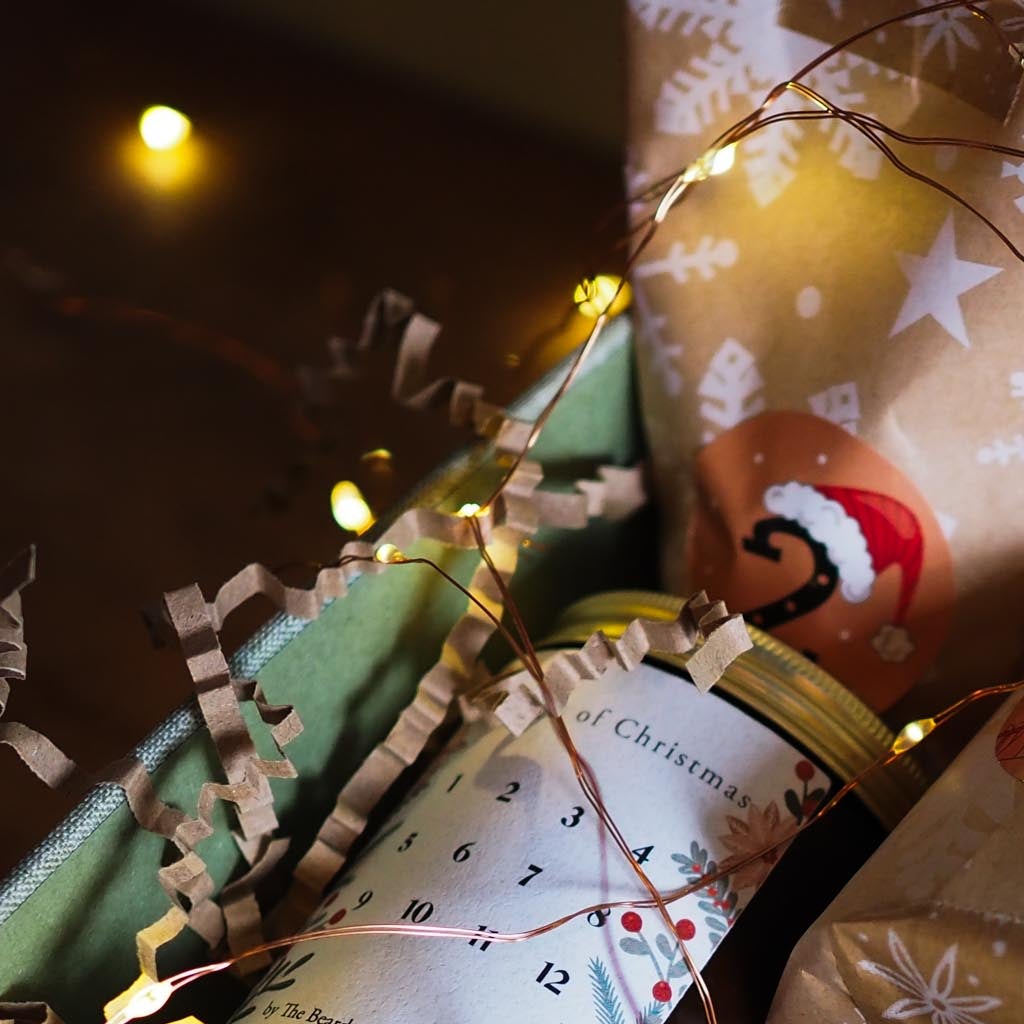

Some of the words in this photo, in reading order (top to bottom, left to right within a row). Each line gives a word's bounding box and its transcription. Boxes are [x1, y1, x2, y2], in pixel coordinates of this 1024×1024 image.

[576, 708, 612, 727] of
[614, 717, 752, 809] Christmas
[397, 832, 418, 853] 5
[452, 842, 477, 863] 6
[518, 864, 543, 886] 7
[447, 773, 463, 793] 1
[496, 781, 520, 803] 2
[560, 806, 585, 828] 3
[631, 845, 654, 865] 4
[352, 890, 374, 911] 9
[400, 899, 434, 924] 10
[535, 961, 570, 996] 12
[262, 1000, 280, 1019] by
[281, 1002, 306, 1020] The
